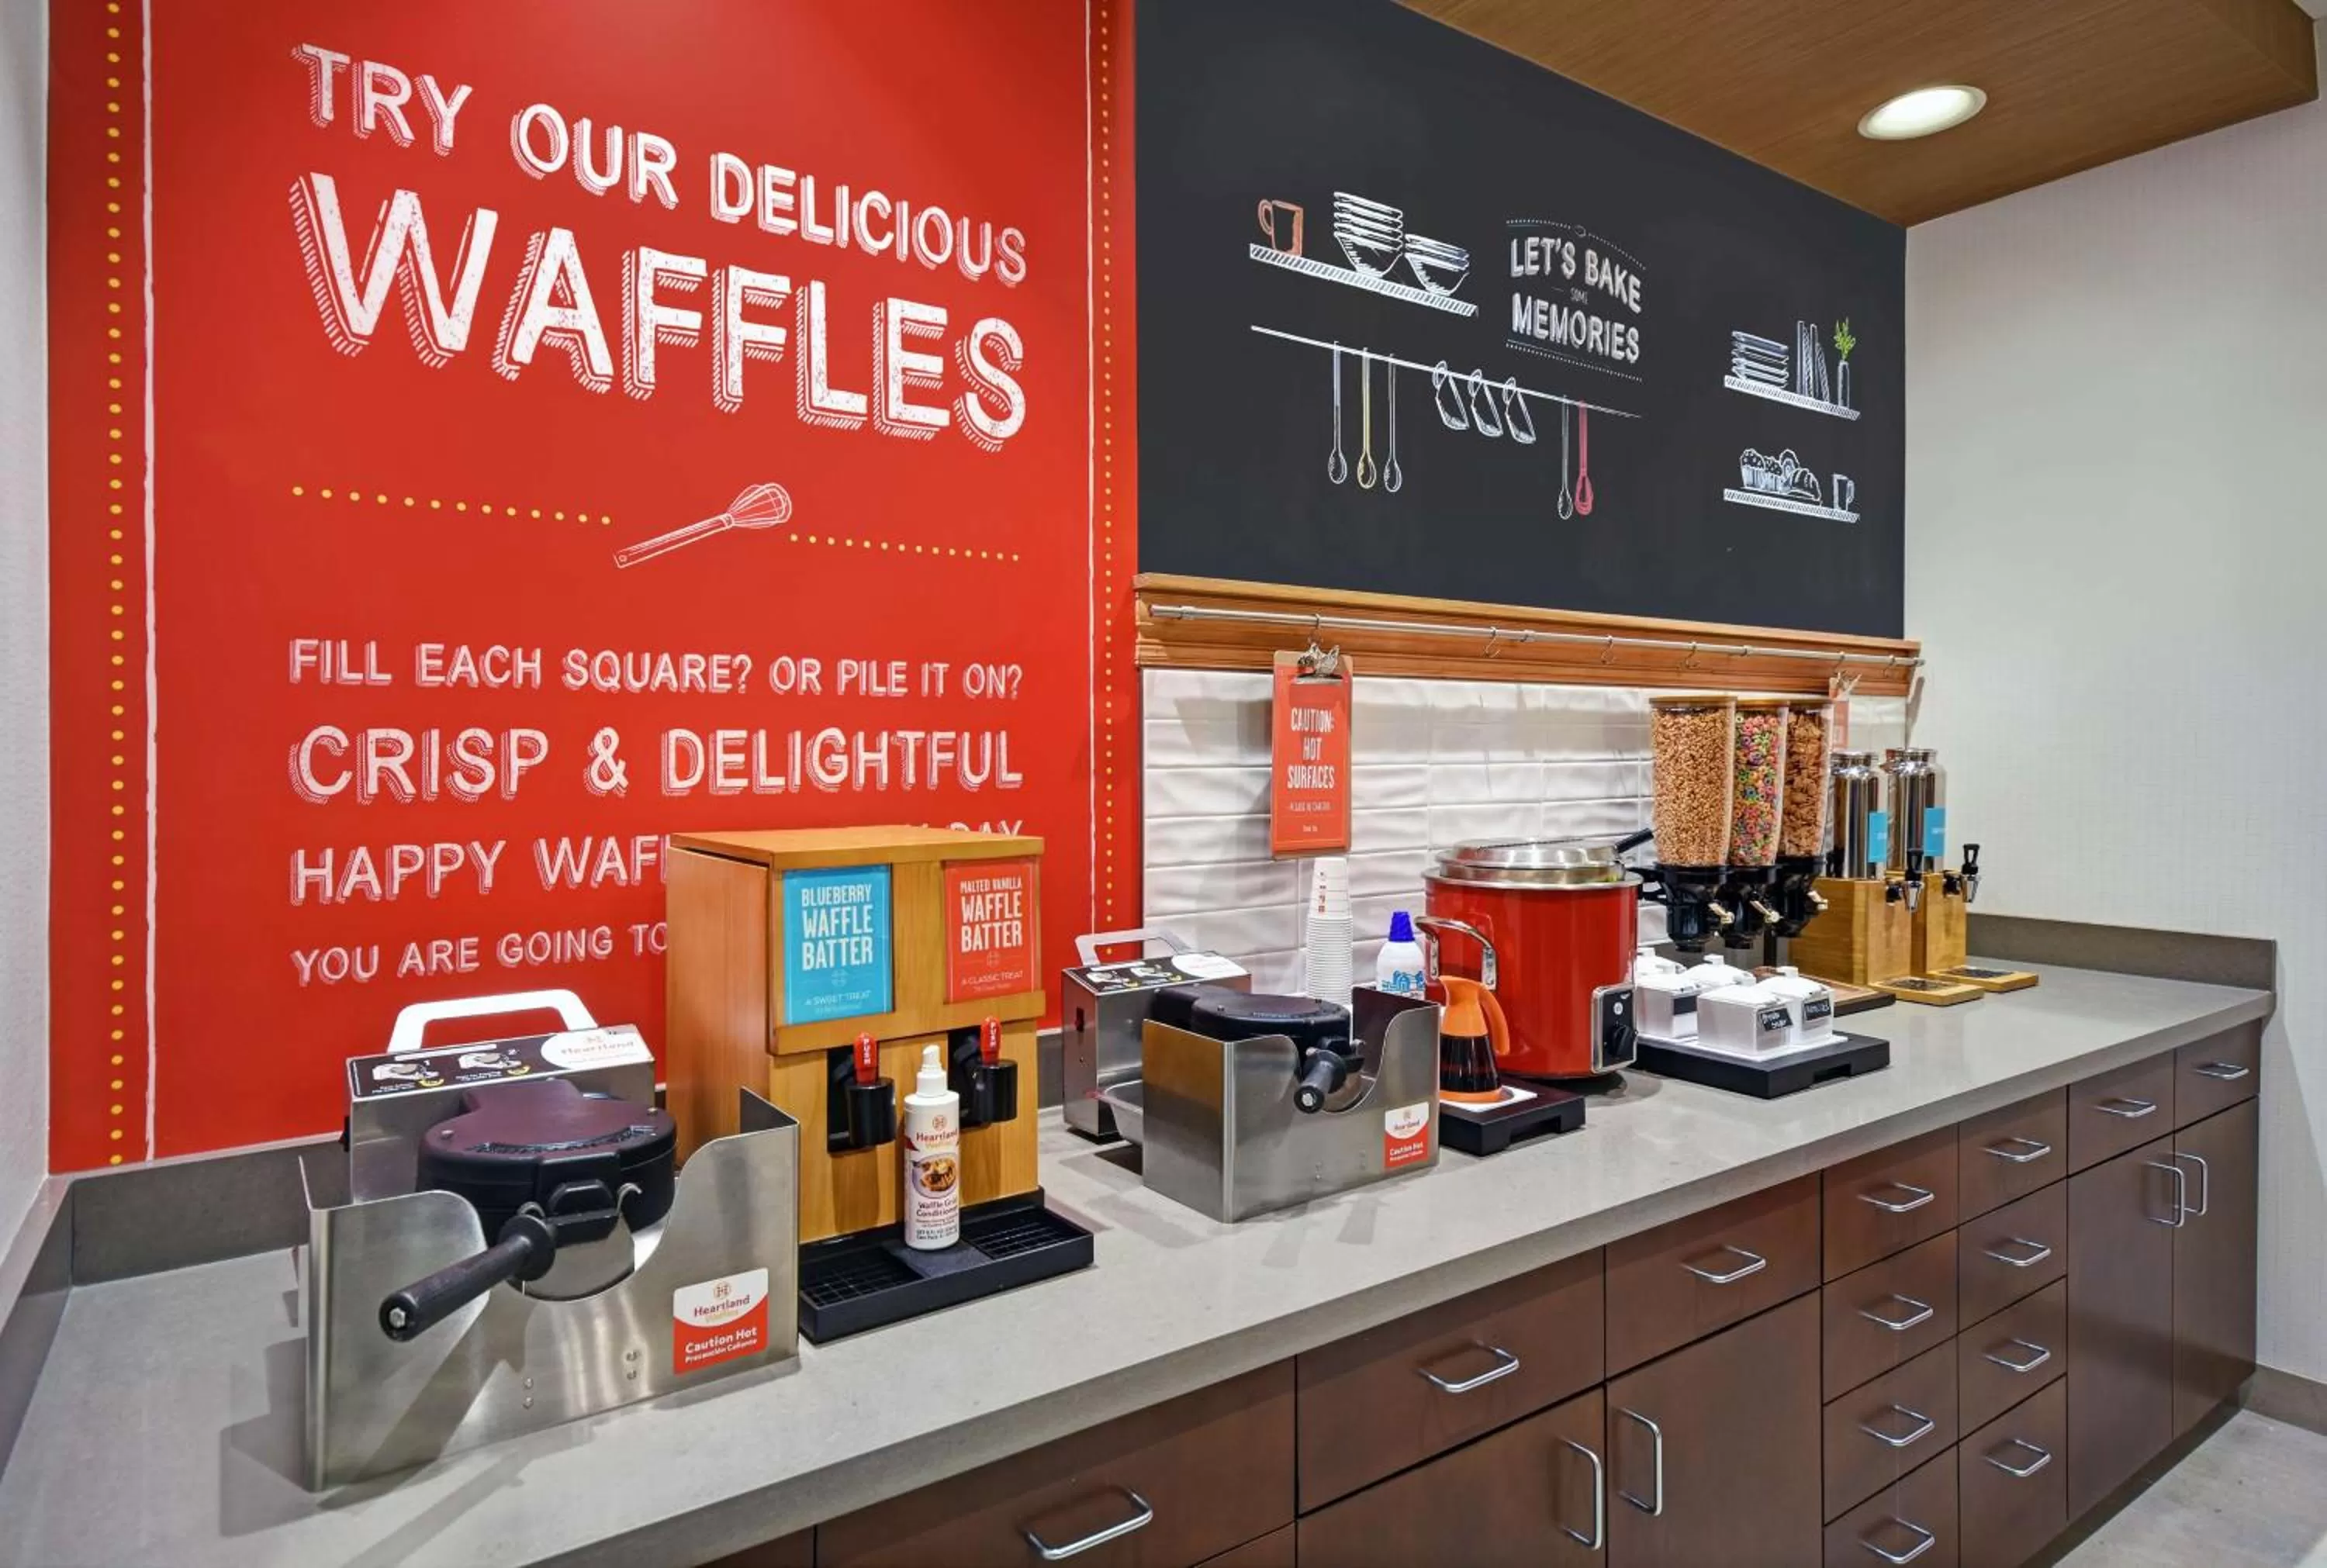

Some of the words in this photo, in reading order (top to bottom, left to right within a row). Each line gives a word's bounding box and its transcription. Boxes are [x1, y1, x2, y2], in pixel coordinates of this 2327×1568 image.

[292, 43, 472, 156] TRY
[510, 103, 678, 210] OUR
[710, 152, 1026, 287] DELICIOUS
[1511, 237, 1576, 280] LET'S
[1585, 249, 1641, 314] BAKE
[289, 171, 1026, 453] WAFFLES
[1513, 293, 1639, 363] MEMORIES
[290, 638, 392, 685] FILL
[416, 643, 541, 688] EACH
[562, 648, 752, 693] SQUARE?
[769, 656, 821, 695] OR
[837, 659, 908, 696] PILE
[921, 661, 949, 696] IT
[963, 663, 1023, 699] ON?
[288, 725, 549, 805] CRISP
[583, 727, 629, 798] &
[661, 727, 1023, 796] DELIGHTFUL
[1303, 737, 1322, 761] HOT
[1287, 765, 1334, 788] SURFACES
[290, 840, 506, 906] HAPPY
[534, 834, 670, 891] WAF
[960, 879, 990, 893] MALTED
[801, 884, 872, 907] BLUEBERRY
[960, 891, 1022, 923] WAFFLE
[802, 905, 873, 939] WAFFLE
[961, 921, 1022, 952] BATTER
[290, 945, 379, 986] YOU
[397, 938, 480, 978] ARE
[497, 926, 613, 967] GOING
[802, 937, 873, 970] BATTER
[693, 1294, 750, 1317] Heartland
[685, 1334, 733, 1354] Caution
[736, 1327, 757, 1342] Hot
